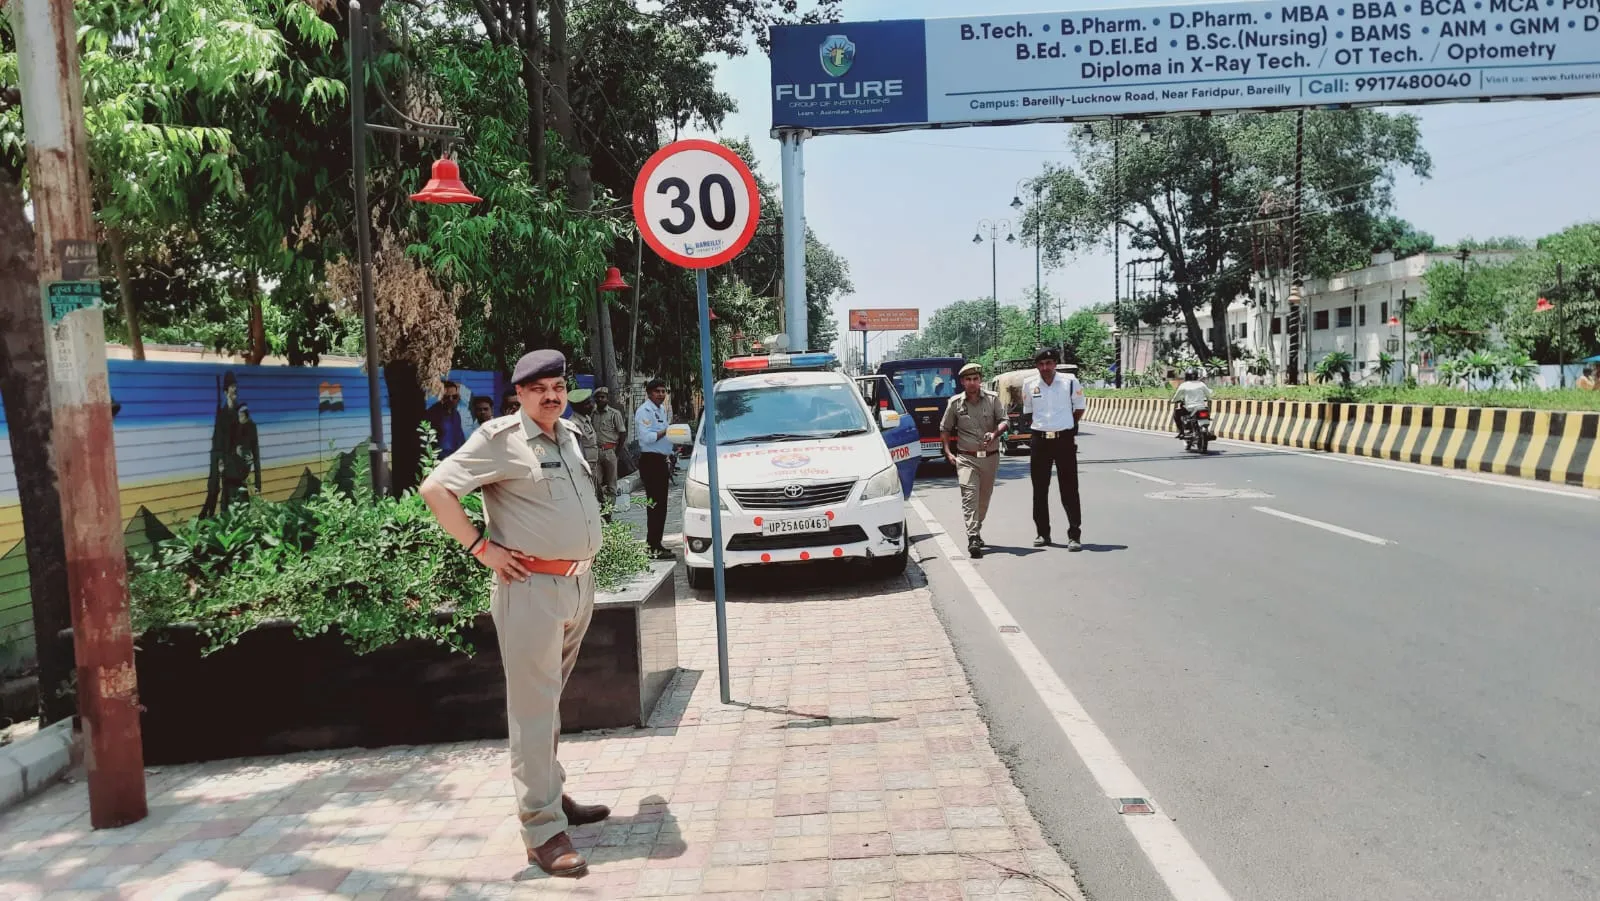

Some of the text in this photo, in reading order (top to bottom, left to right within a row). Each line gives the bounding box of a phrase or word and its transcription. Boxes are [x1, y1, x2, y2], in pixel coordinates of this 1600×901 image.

[961, 21, 1032, 40] B.Tech.
[1061, 17, 1146, 35] B.Pharm.
[1170, 11, 1258, 29] D.Pharm.
[1282, 5, 1329, 23] MBA
[1353, 1, 1397, 19] BBA
[1421, 0, 1466, 16] BCA
[1490, 0, 1539, 13] MCA
[1016, 42, 1066, 60] B.Ed.
[1089, 36, 1157, 56] D.El.Ed
[1187, 25, 1327, 50] B.Sc.(Nursing)
[1351, 23, 1411, 42] BAMS
[1440, 20, 1486, 38] ANM
[1510, 17, 1559, 35] GNM
[1081, 60, 1162, 82] Diploma
[1168, 58, 1184, 74] in
[1191, 55, 1251, 74] X-Ray
[1257, 51, 1311, 69] Tech.
[1335, 48, 1363, 65] OT
[1369, 46, 1423, 64] Tech.
[1447, 41, 1556, 64] Optometry
[776, 80, 903, 100] FUTURE
[970, 83, 1291, 110] Campus: Bareilly-Lucknow Road, Near Faridpur, Bareilly
[1308, 73, 1471, 94] Call: 9917480040
[833, 97, 890, 106] INSTITUTIONS
[657, 173, 736, 235] 30
[769, 518, 828, 533] UP25AG0463
